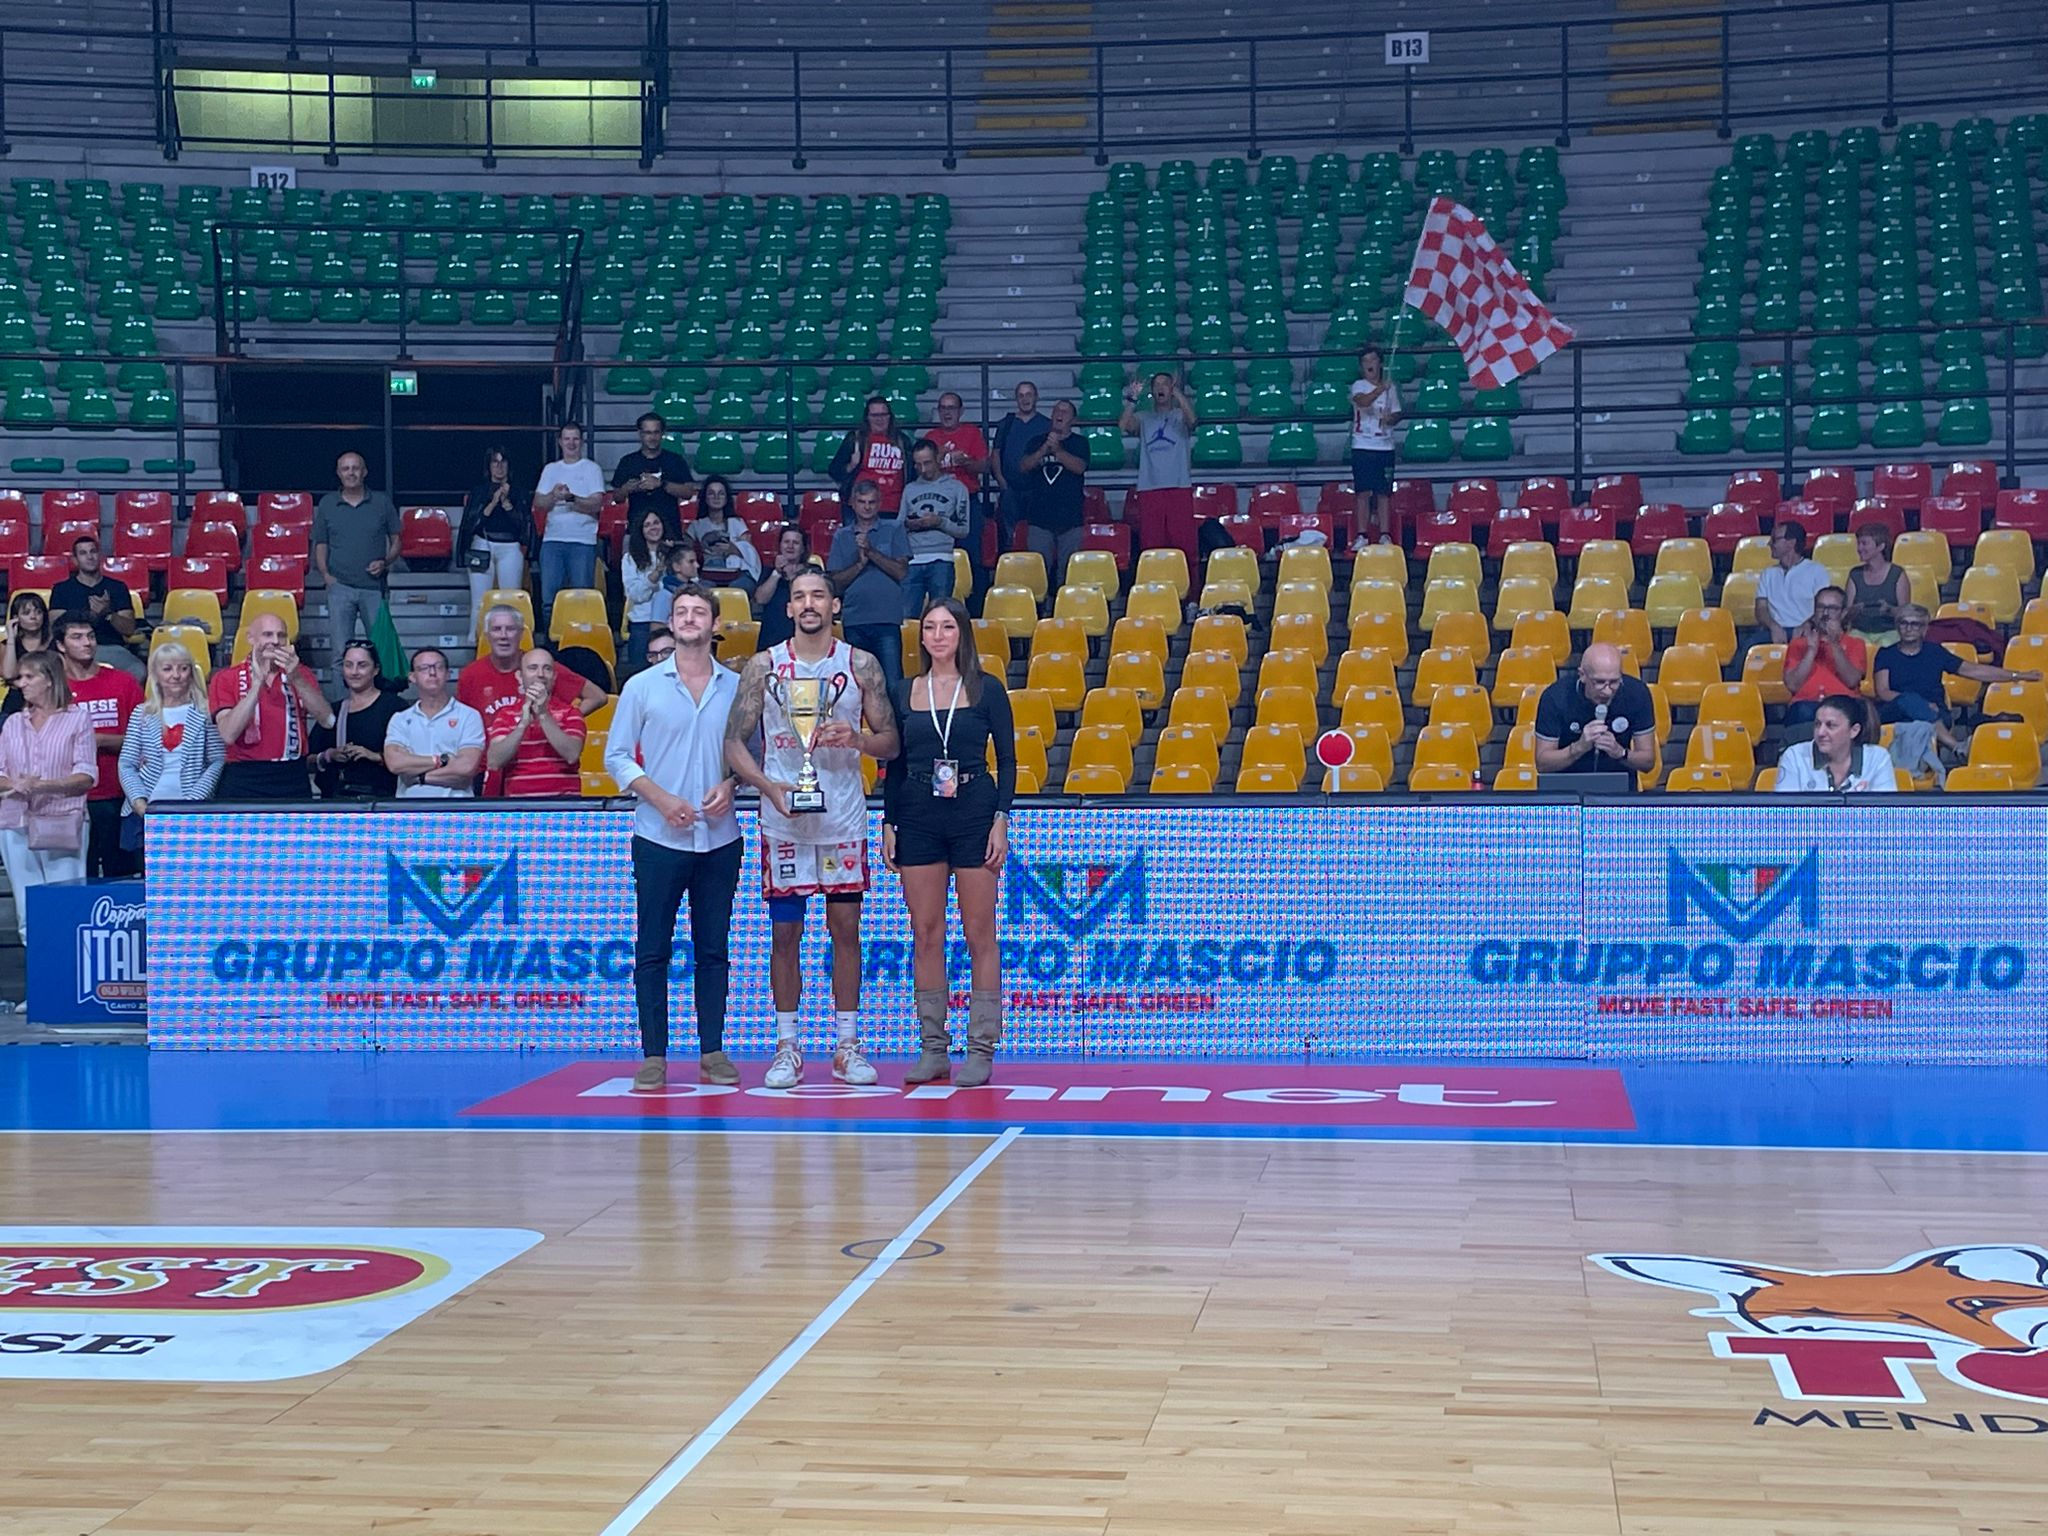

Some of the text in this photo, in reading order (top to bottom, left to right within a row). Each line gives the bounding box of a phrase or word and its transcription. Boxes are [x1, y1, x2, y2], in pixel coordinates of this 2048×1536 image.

[1391, 39, 1422, 57] B13
[258, 172, 289, 188] B12
[871, 443, 901, 458] RUN
[868, 458, 890, 469] WITH
[777, 662, 795, 680] 21
[212, 939, 695, 981] GRUPPO MASCO
[1090, 940, 1337, 983] MASCIO
[1470, 940, 2025, 990] GRUPPO MASCIO
[327, 991, 385, 1009] MOVE
[514, 991, 584, 1010] GREEN
[1141, 992, 1214, 1012] GREEN
[1598, 995, 1664, 1015] MOVE
[1811, 998, 1892, 1019] GREEN
[1753, 1407, 2048, 1434] MEND
